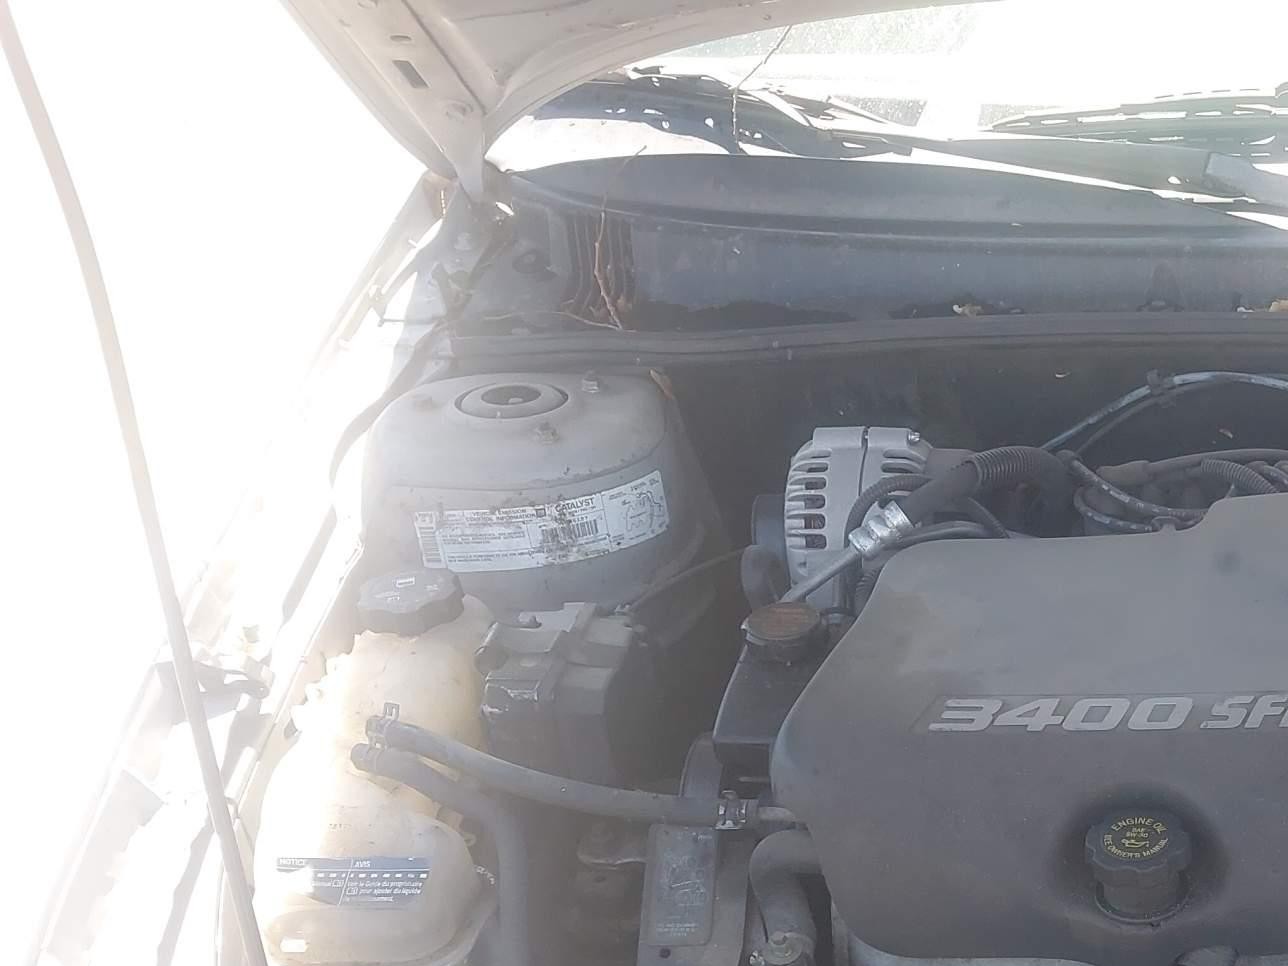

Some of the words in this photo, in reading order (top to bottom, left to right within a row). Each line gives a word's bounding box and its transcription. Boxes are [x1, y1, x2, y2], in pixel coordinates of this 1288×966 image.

[554, 498, 595, 513] CATALYST
[928, 697, 1194, 732] 3400
[1111, 817, 1154, 831] ENGINE
[354, 860, 371, 868] AVIS
